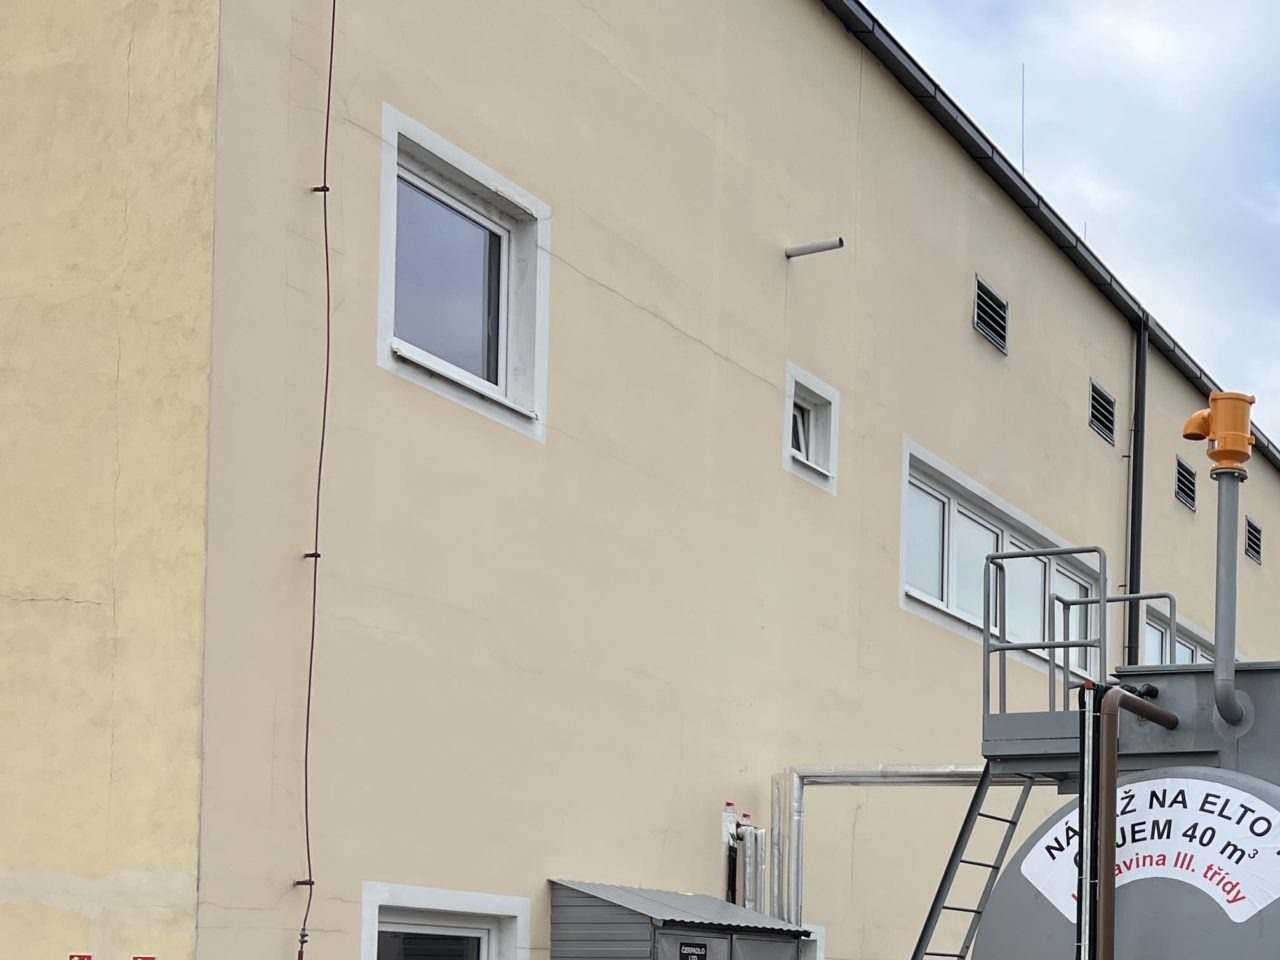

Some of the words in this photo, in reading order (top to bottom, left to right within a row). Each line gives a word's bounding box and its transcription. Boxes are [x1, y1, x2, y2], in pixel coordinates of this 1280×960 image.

[1045, 789, 1137, 860] NÁŽ
[1148, 788, 1188, 809] NA
[1199, 793, 1272, 837] ELTO
[1182, 822, 1216, 847] 40
[1203, 864, 1247, 904] třídy
